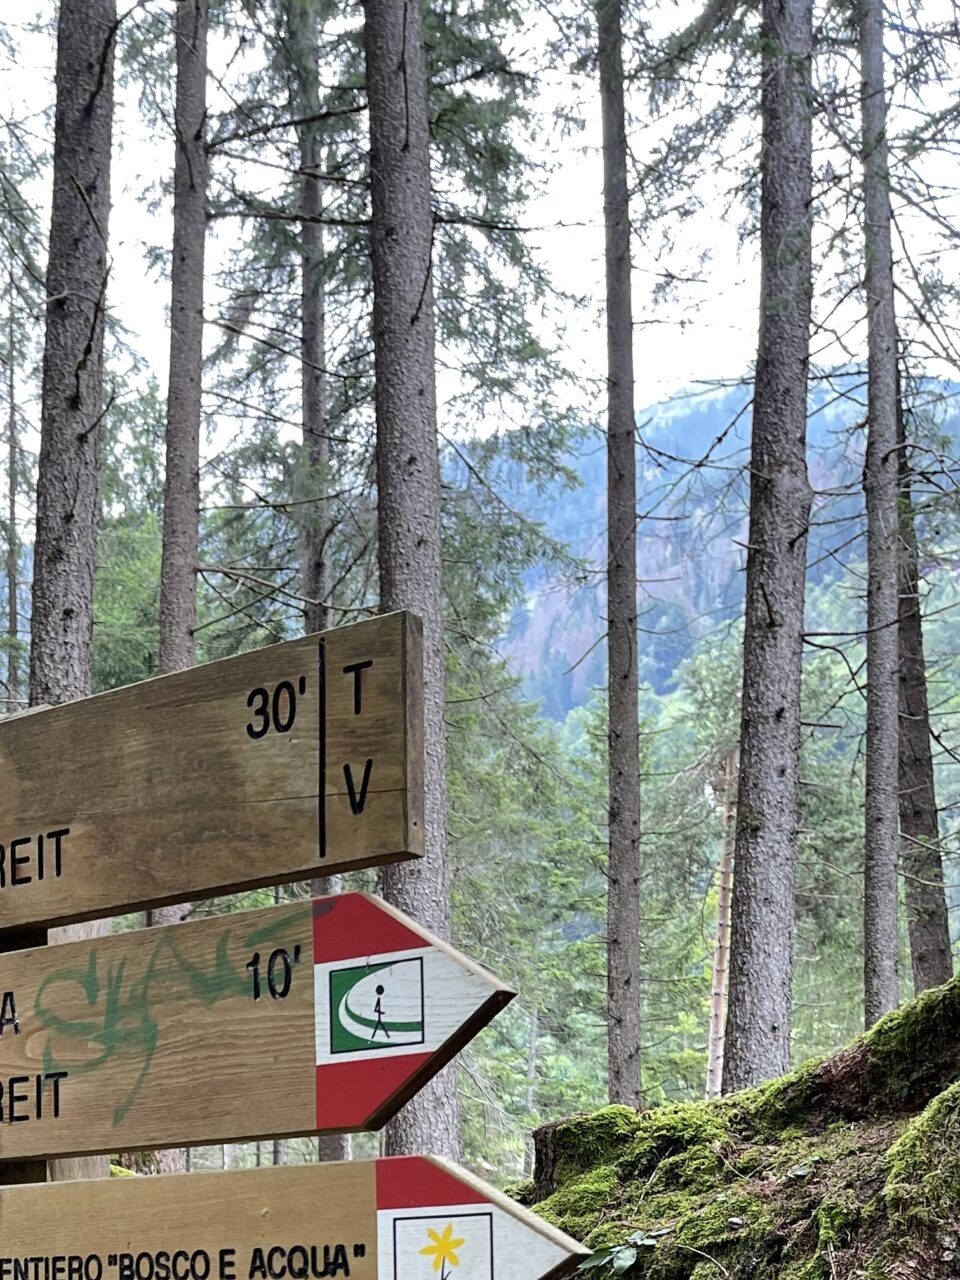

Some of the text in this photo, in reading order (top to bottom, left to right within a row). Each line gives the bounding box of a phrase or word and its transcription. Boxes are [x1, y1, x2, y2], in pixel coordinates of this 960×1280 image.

[245, 675, 307, 741] 30'
[342, 659, 374, 716] T
[342, 757, 373, 816] V
[245, 943, 302, 1002] 10'
[218, 1247, 236, 1280] E
